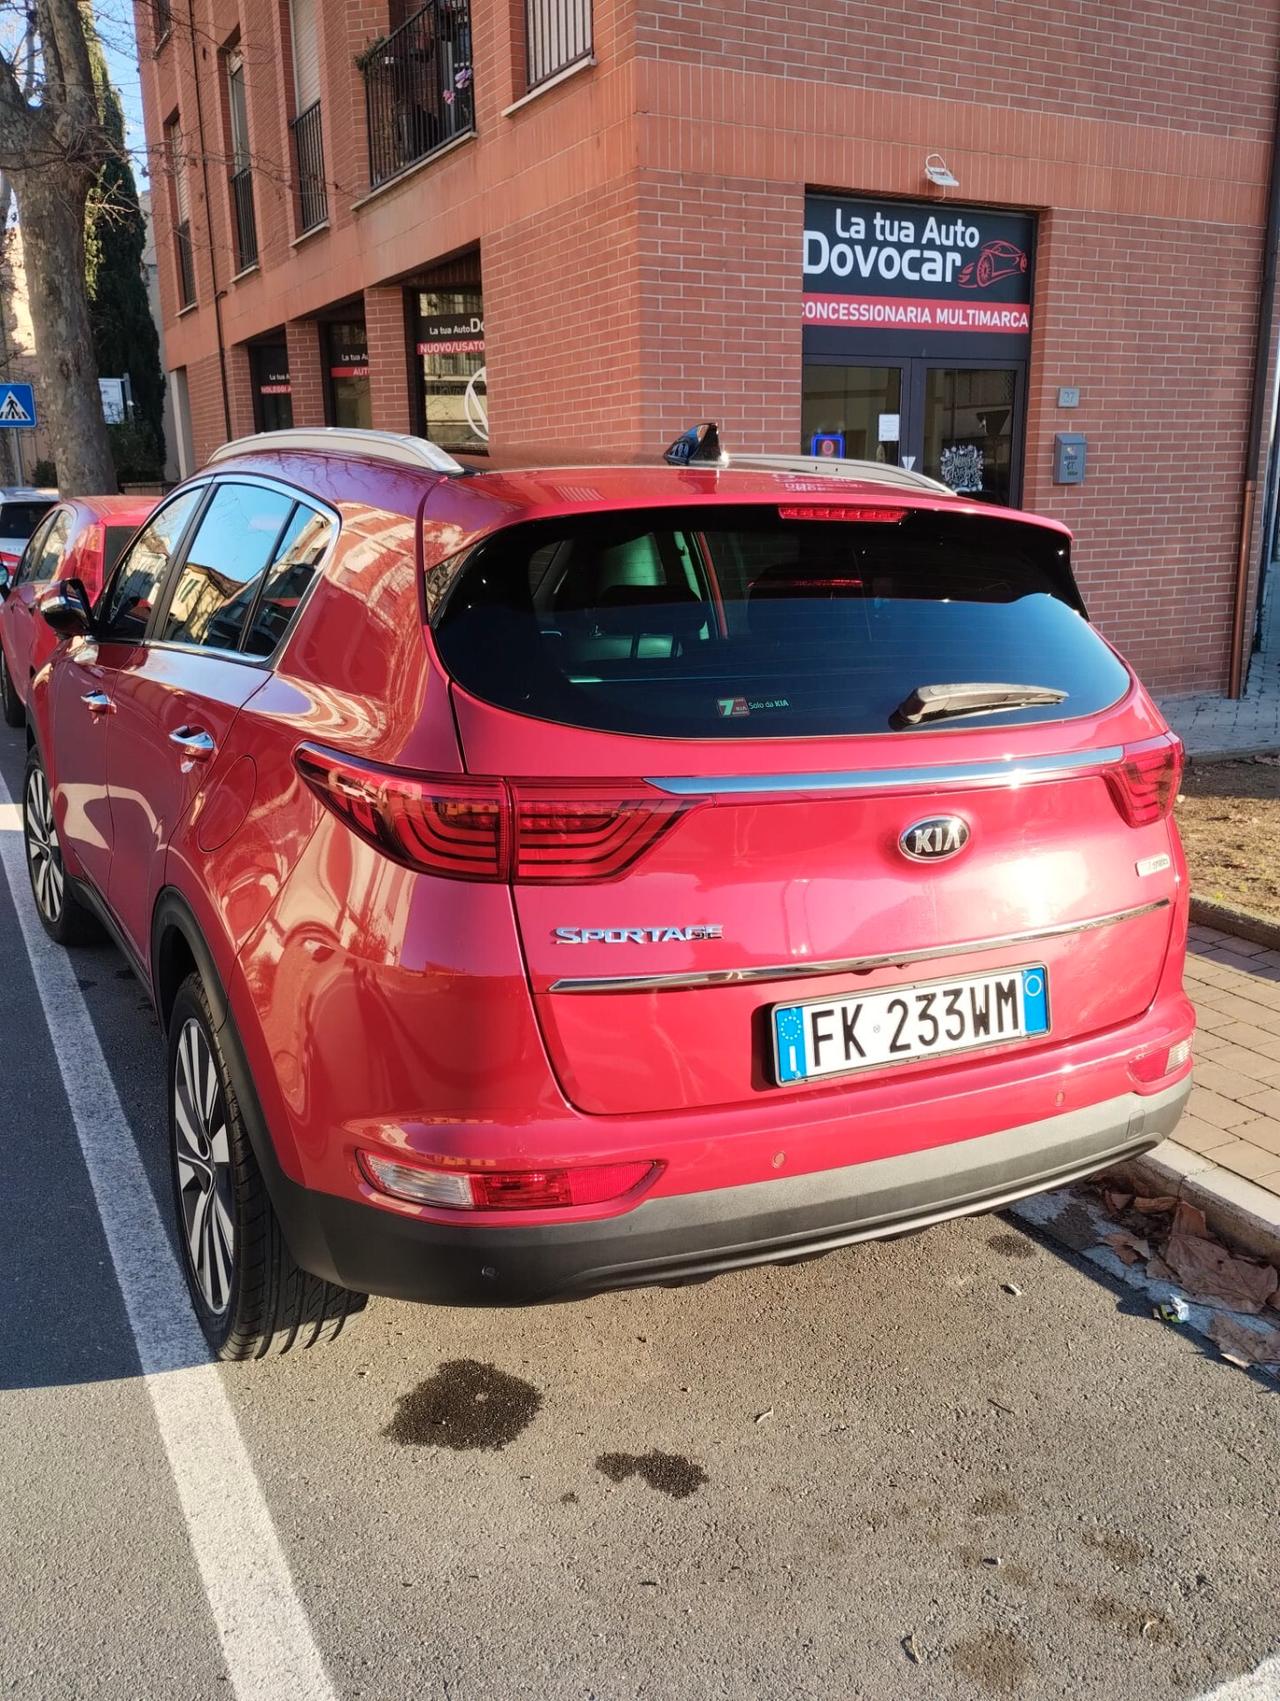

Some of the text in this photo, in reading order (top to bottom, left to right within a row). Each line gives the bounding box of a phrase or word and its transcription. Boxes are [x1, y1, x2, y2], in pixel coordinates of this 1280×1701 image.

[836, 207, 980, 249] La tua Auto
[803, 230, 962, 282] Dovocar
[936, 307, 1029, 329] MULTIMARCA
[429, 326, 439, 335] La
[439, 326, 452, 335] tua
[453, 325, 471, 334] Auto
[419, 340, 486, 353] NUOVO/USATO
[353, 366, 370, 377] AUT
[719, 699, 734, 716] 7
[748, 701, 765, 710] Solo
[765, 700, 774, 708] da
[774, 699, 789, 707] KIA
[914, 821, 961, 854] KIA
[555, 923, 724, 946] SPORTAGE
[810, 1003, 867, 1068] FK
[886, 978, 1020, 1055] 233WM
